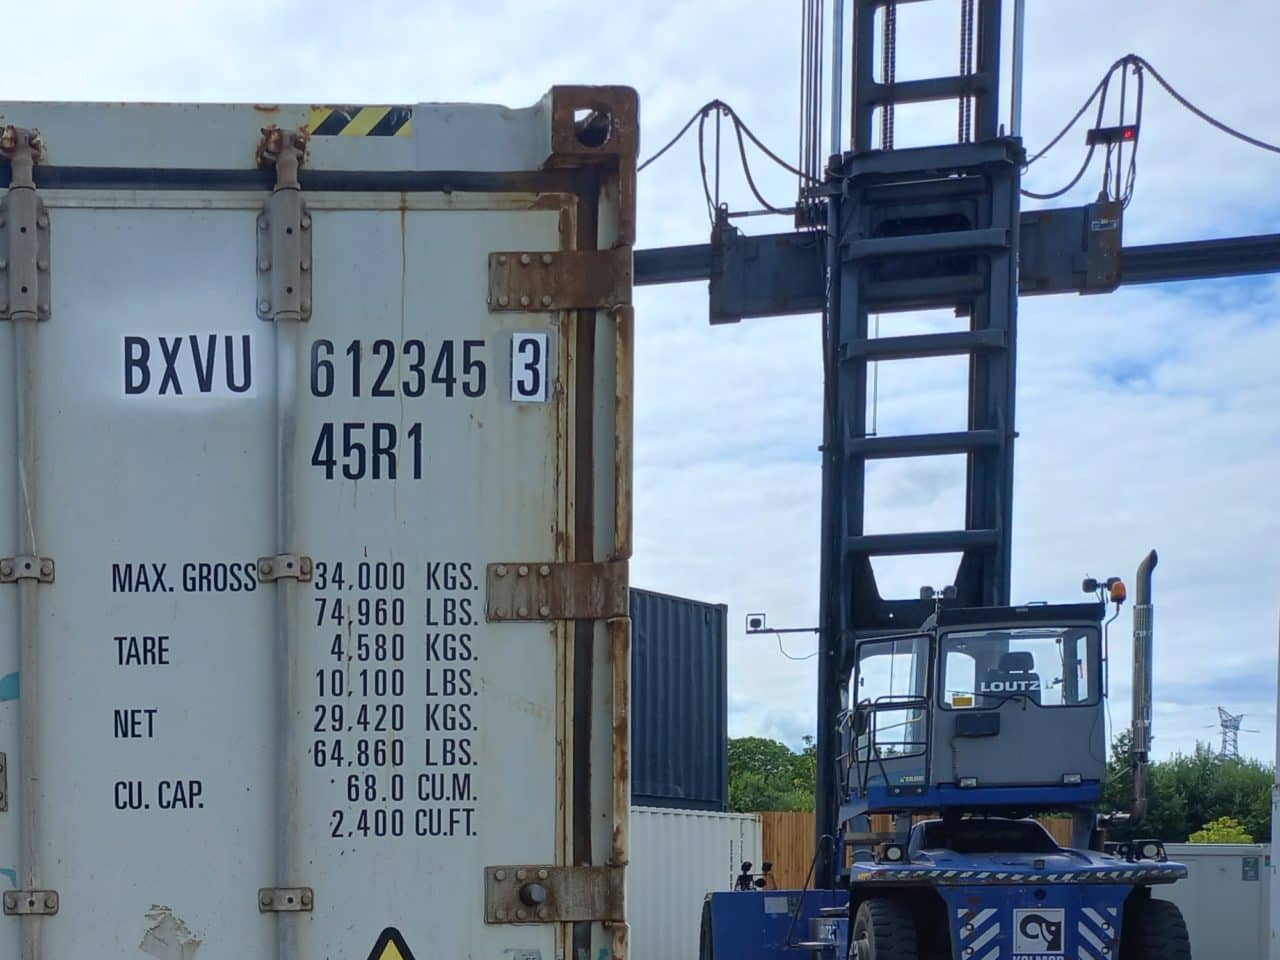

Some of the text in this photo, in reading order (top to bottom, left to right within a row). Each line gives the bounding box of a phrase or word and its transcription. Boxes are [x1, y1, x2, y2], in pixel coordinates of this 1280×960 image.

[125, 334, 251, 395] BXVU
[311, 339, 486, 397] 612345
[312, 423, 421, 480] 45R1
[113, 563, 174, 592] MAX.
[182, 562, 258, 592] GROSS
[427, 562, 478, 590] KGS.
[426, 598, 478, 626] LBS.
[114, 636, 169, 665] TARE
[426, 633, 478, 661] KGS.
[426, 669, 478, 696] LBS.
[114, 710, 157, 738] NET
[426, 704, 477, 731] KGS.
[426, 739, 477, 766] LBS.
[115, 781, 149, 809] CU.
[159, 781, 203, 809] CAP.
[418, 773, 477, 801] CU.M.
[416, 808, 476, 836] CU.FT.
